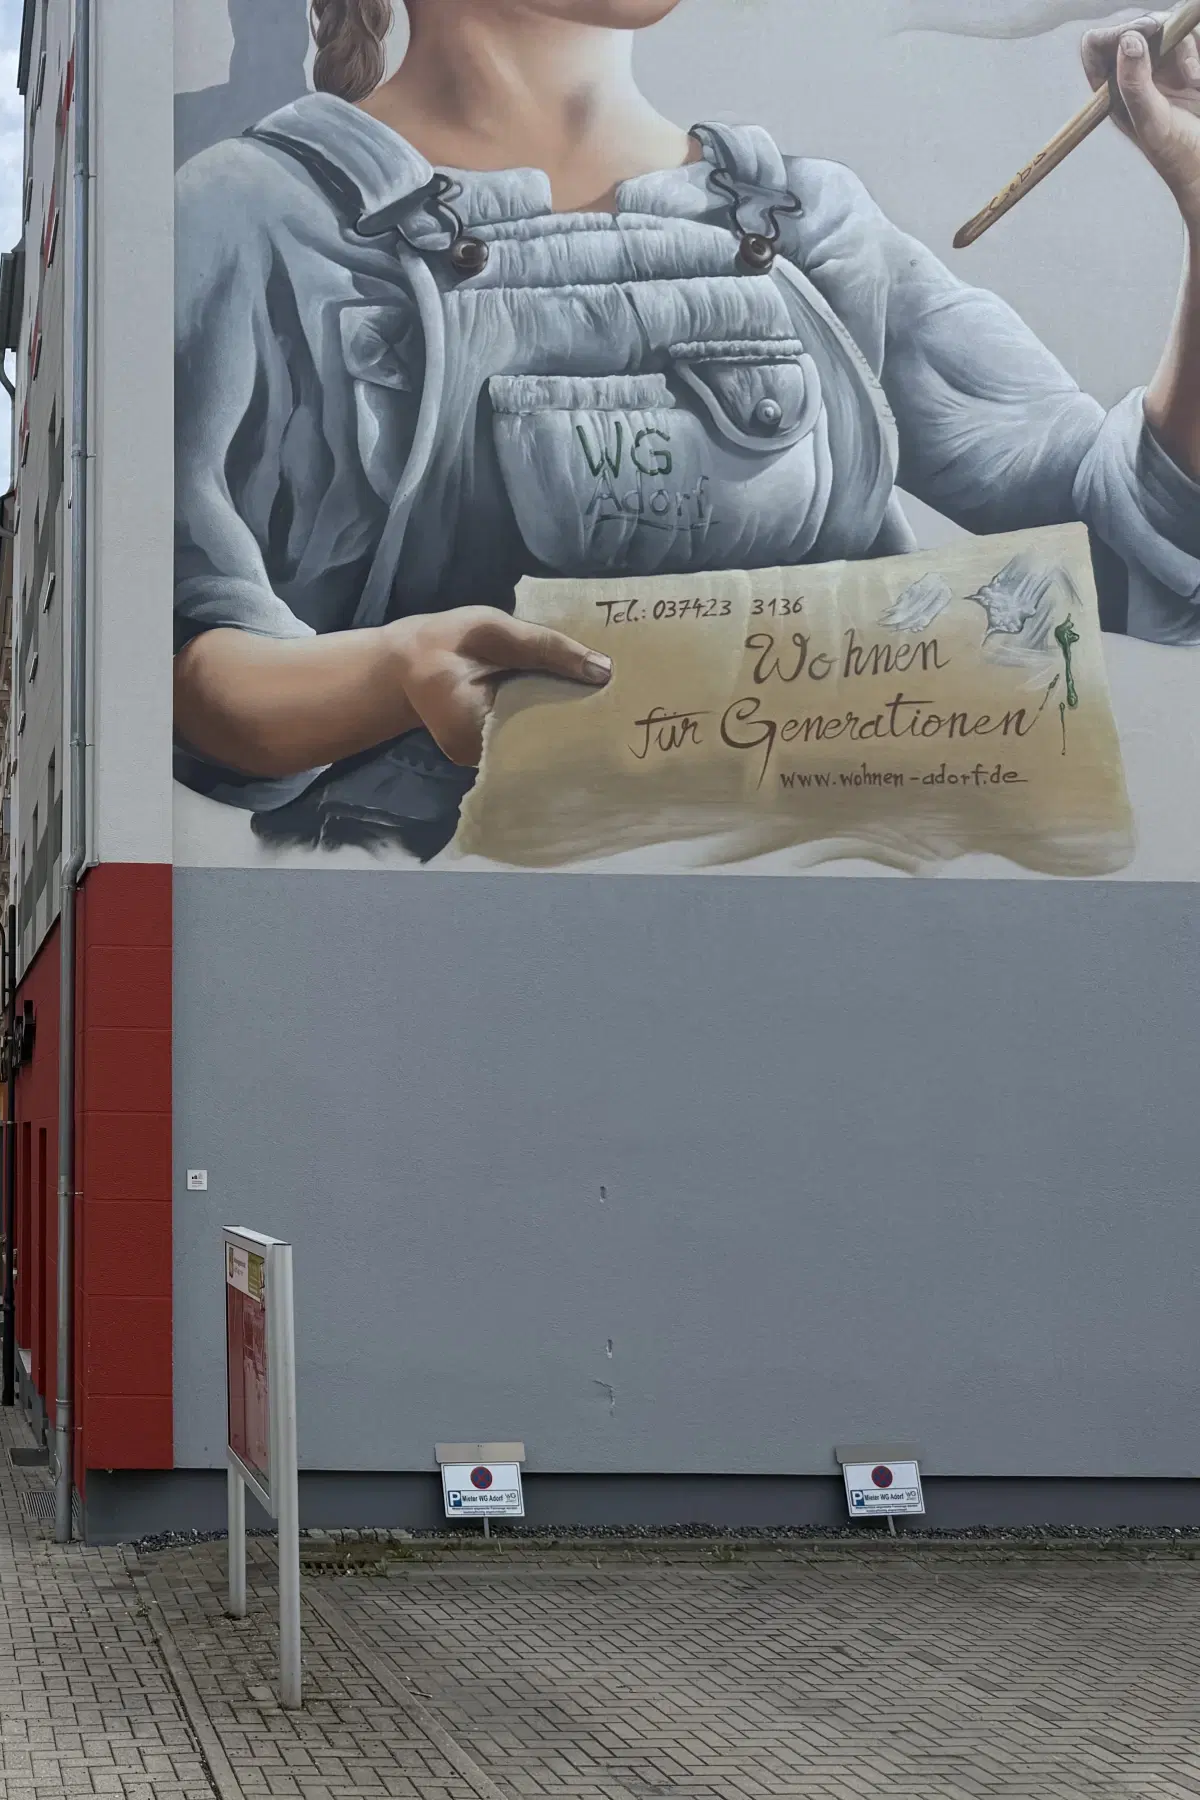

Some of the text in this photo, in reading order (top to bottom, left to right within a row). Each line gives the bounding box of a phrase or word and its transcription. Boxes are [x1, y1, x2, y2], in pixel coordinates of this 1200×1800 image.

[576, 421, 672, 479] WG
[585, 470, 709, 518] Adorf
[653, 598, 732, 620] 037423
[751, 596, 804, 616] 3136
[744, 628, 951, 684] Wohnen
[628, 693, 1038, 790] für Generationen
